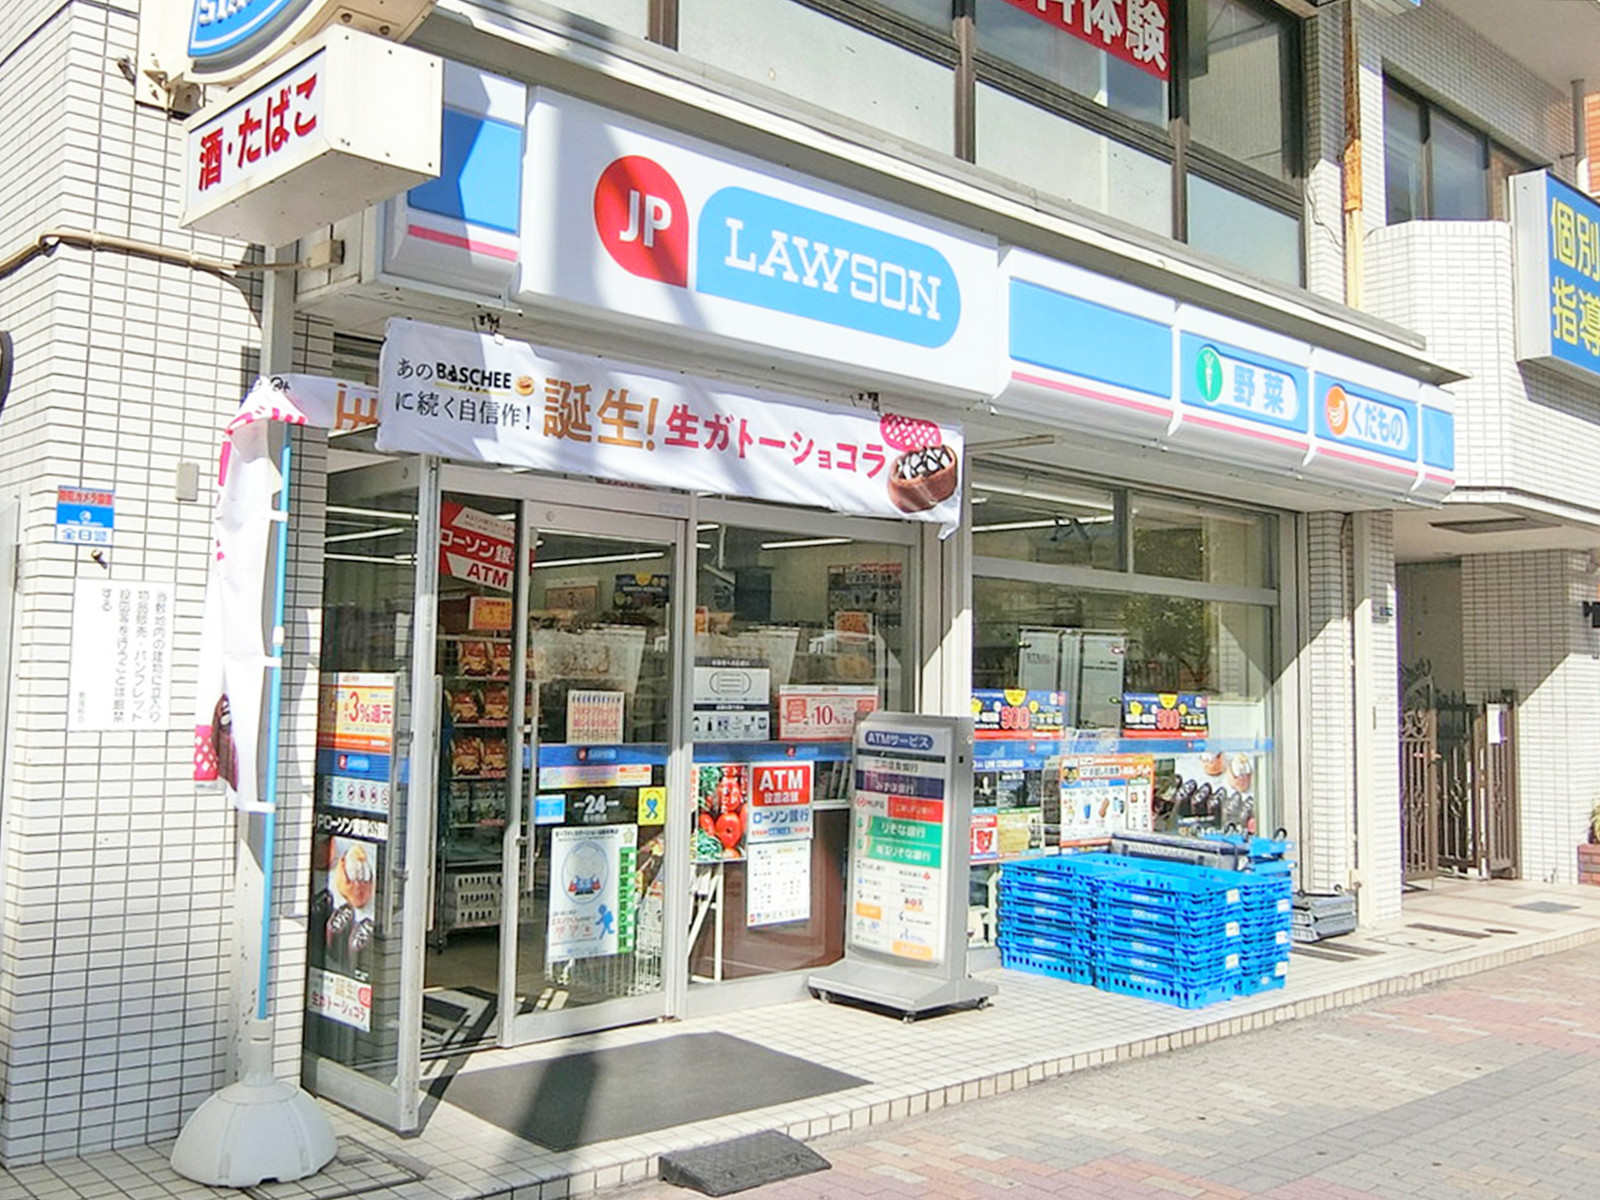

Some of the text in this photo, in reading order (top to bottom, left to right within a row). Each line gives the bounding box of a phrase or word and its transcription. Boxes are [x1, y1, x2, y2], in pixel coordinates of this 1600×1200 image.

[619, 190, 673, 249] JP
[724, 218, 941, 321] LAWSON
[395, 390, 531, 430] に続く自信作!
[1231, 364, 1286, 415] 野菜
[543, 377, 886, 479] 誕生! 生ガトーショコラ
[1350, 404, 1404, 446] くだもの
[467, 562, 509, 588] ATM
[867, 732, 931, 748] ATMサービス
[759, 769, 804, 791] ATM
